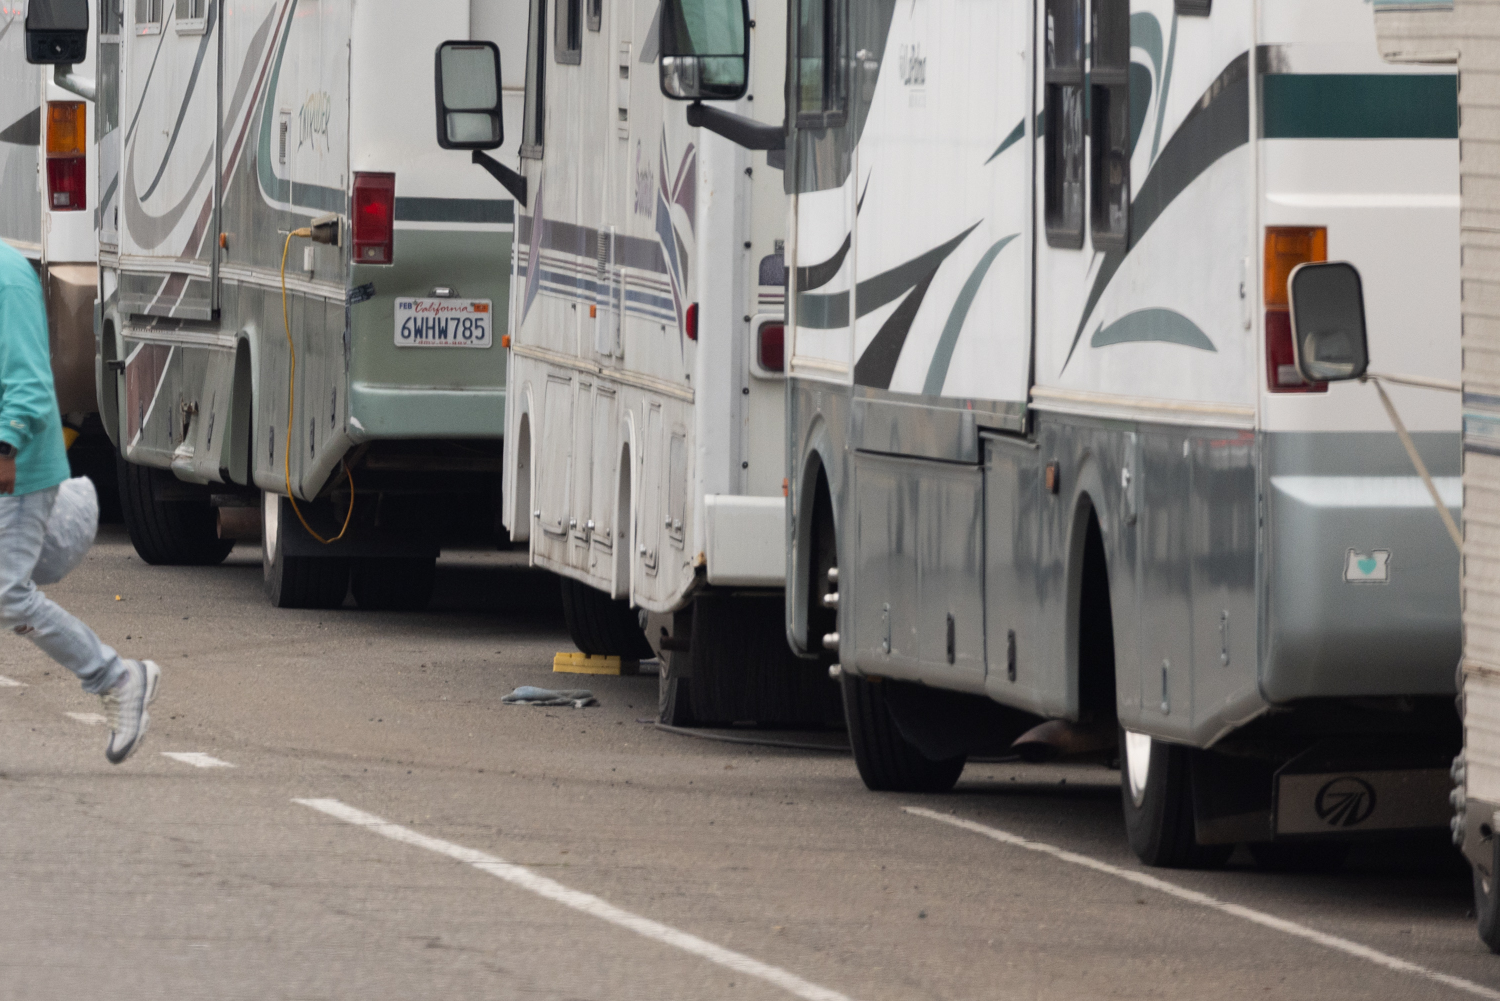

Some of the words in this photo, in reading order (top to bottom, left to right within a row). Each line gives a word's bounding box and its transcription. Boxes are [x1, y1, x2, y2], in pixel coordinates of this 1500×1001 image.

[399, 302, 412, 310] FEB
[414, 301, 469, 316] California
[401, 316, 486, 340] 6WHW785
